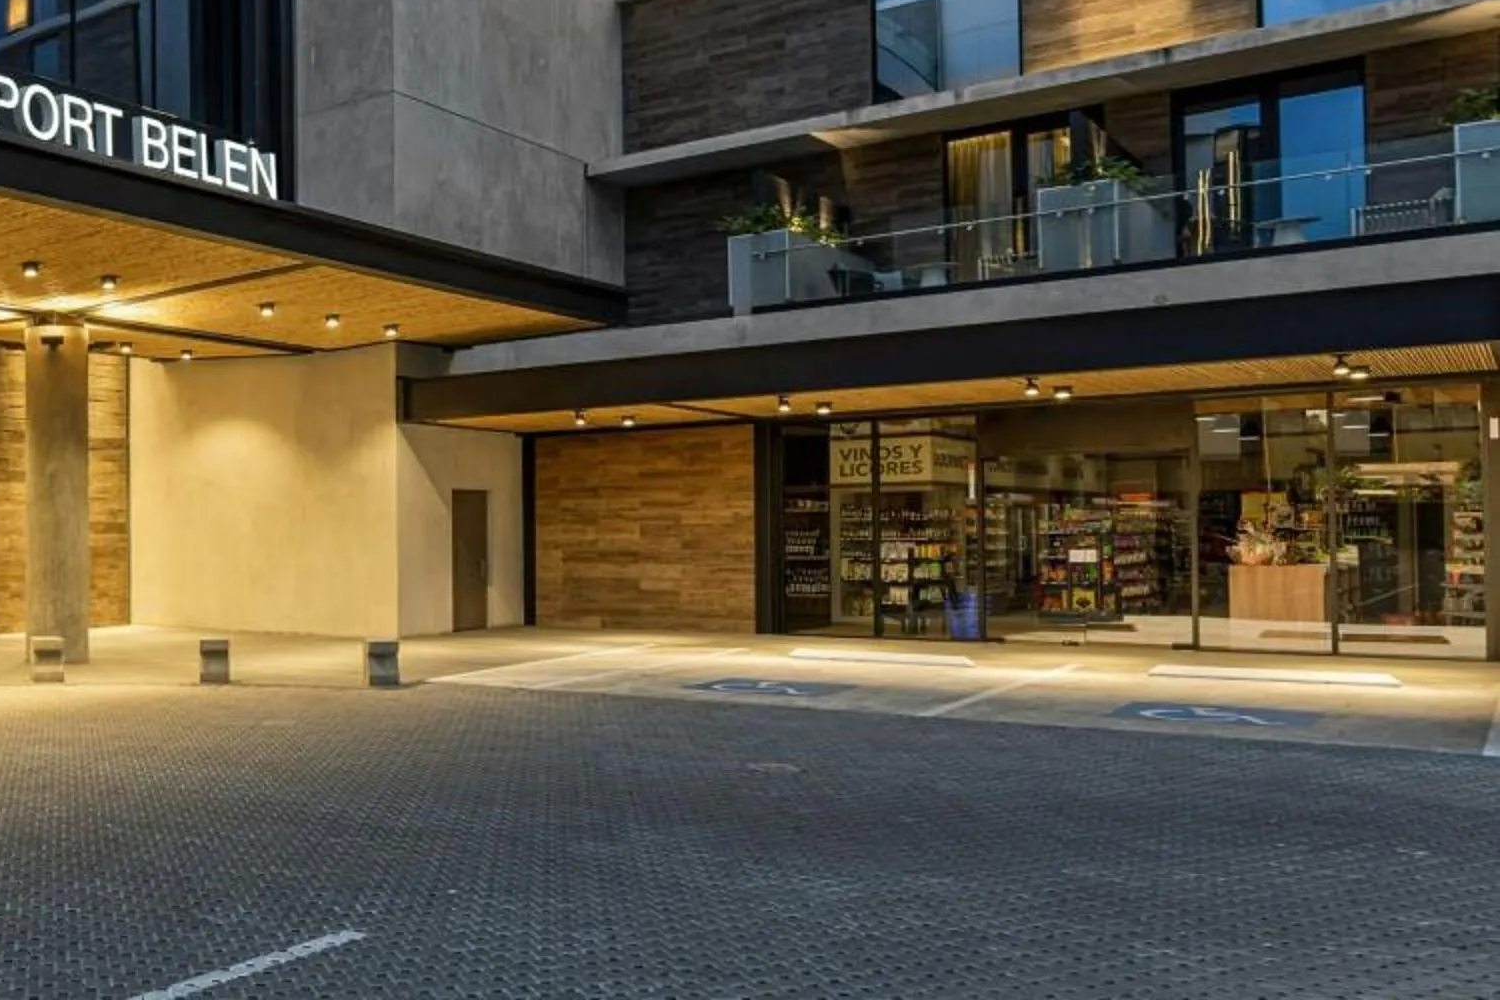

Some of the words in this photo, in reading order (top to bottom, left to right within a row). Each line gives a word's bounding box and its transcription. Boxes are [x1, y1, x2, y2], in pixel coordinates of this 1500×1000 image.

[136, 115, 278, 200] BELEN
[839, 444, 903, 462] VINOS
[909, 443, 923, 459] Y
